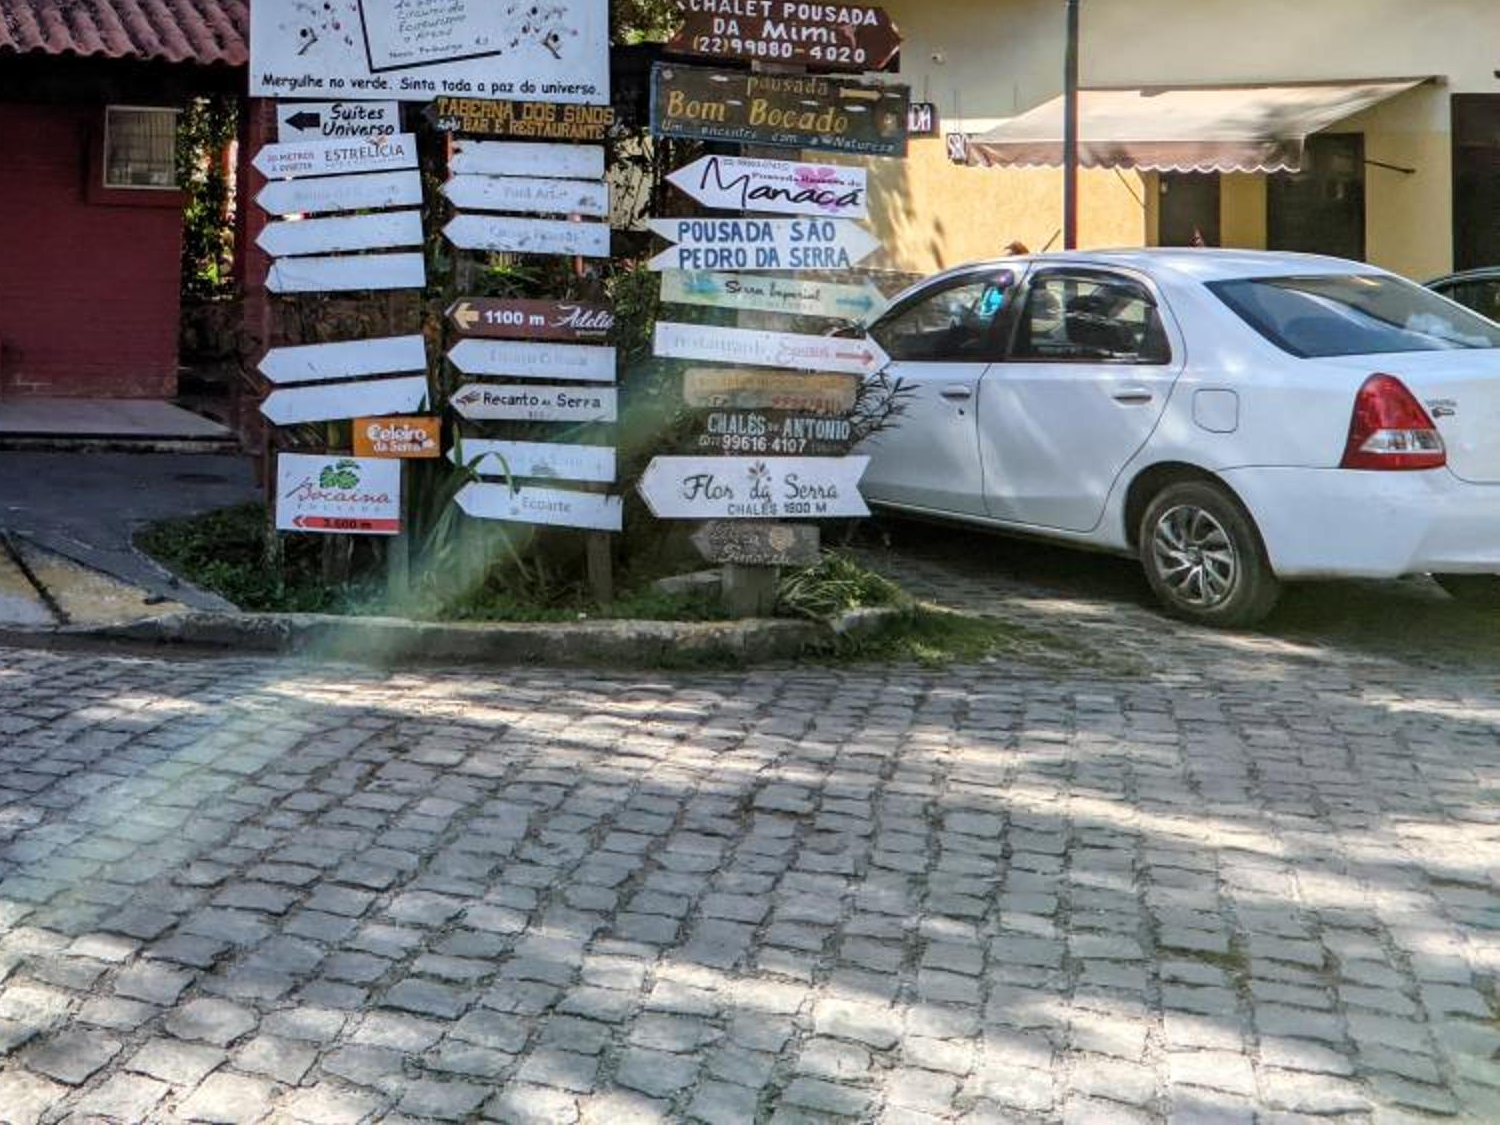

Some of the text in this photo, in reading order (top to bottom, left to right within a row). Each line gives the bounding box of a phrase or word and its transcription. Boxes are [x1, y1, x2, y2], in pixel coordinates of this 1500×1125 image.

[783, 3, 878, 25] POUSADA
[713, 18, 837, 44] DA Mimi
[262, 73, 601, 96] Mergulhe no verde. Sinta toda a paz do universo.
[747, 76, 828, 97] pousada
[437, 97, 615, 125] TABERNA DOS SINOS
[667, 90, 848, 133] Bom Bocado
[322, 122, 394, 136] Universo
[463, 117, 491, 133] BAR
[495, 118, 504, 133] E
[510, 120, 605, 140] RESTAURANTE
[700, 156, 864, 207] Manacá
[678, 221, 774, 242] POUSADA
[679, 247, 850, 269] PEDRO DA SERRA
[484, 310, 524, 324] 1100
[529, 314, 545, 325] m
[483, 391, 539, 406] Recanto
[557, 393, 601, 408] Serra
[367, 424, 427, 442] Celeiro
[373, 441, 388, 452] da
[683, 474, 734, 500] Flor
[784, 473, 838, 500] Serra
